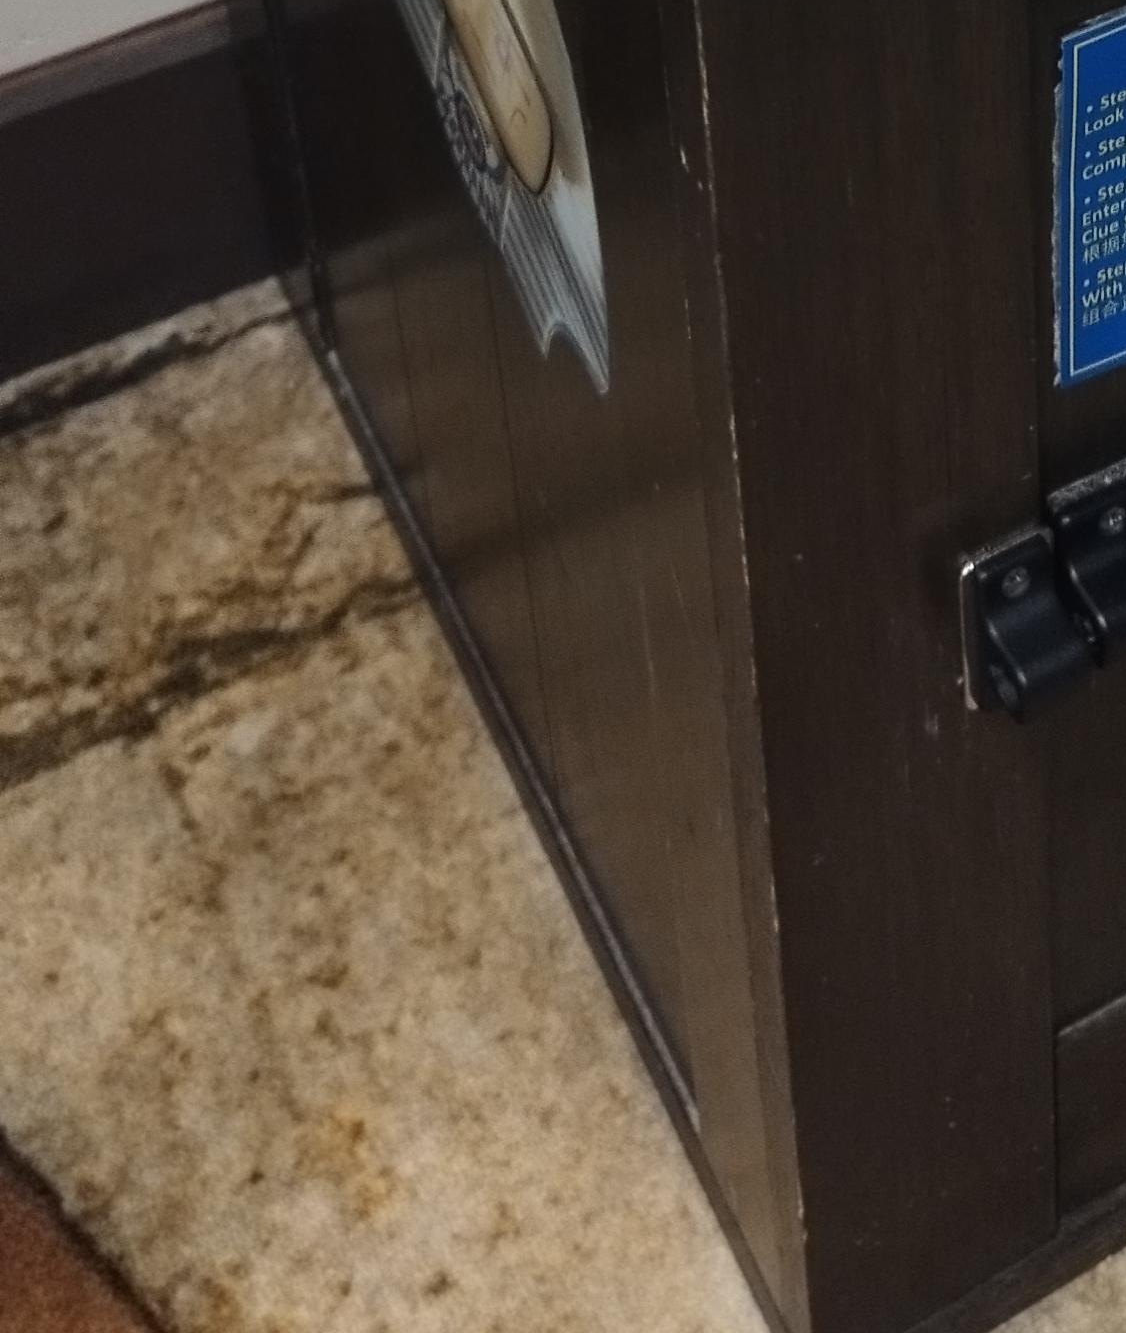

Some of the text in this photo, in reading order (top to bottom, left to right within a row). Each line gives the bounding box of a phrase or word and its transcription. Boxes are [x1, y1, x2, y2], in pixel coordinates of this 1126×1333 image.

[1084, 108, 1124, 135] Look
[1082, 197, 1126, 226] Enter
[1082, 219, 1120, 246] Clue
[1082, 280, 1122, 308] With
